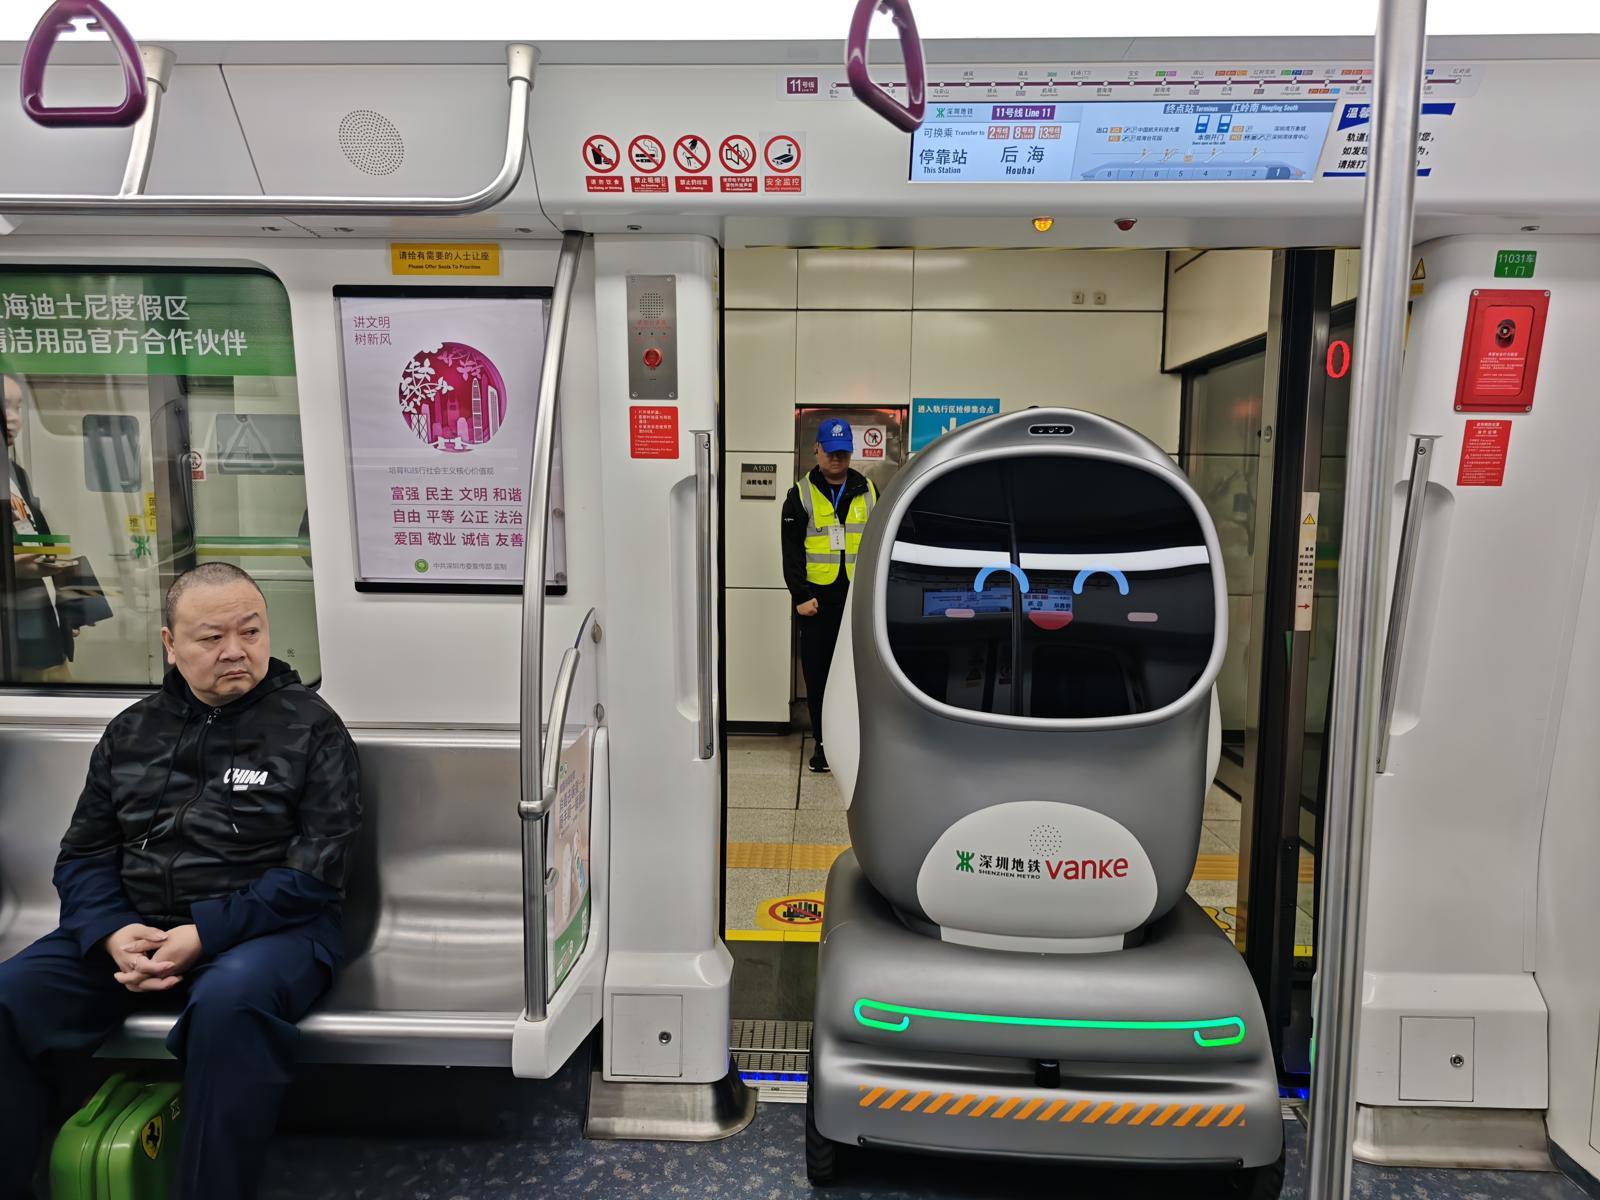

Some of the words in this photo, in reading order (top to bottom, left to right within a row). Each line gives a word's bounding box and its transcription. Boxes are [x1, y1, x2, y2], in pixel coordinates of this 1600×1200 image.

[789, 79, 815, 92] 11号线
[996, 107, 1023, 117] 11号线
[1024, 107, 1040, 117] Line
[1042, 106, 1051, 116] 11
[1167, 104, 1194, 114] 终点站
[924, 127, 953, 139] 可换乘
[919, 148, 968, 165] 停靠站
[1000, 145, 1045, 163] 后海
[923, 166, 936, 174] This
[938, 166, 961, 174] Station
[1006, 166, 1035, 175] Houhai
[766, 178, 800, 186] 安全监控
[0, 293, 190, 320] 海迪士尼度假区
[353, 316, 390, 329] 讲文明
[0, 328, 248, 356] 洁用品官方合作伙伴
[354, 333, 392, 346] 树新风
[391, 486, 420, 501] 富强
[426, 486, 454, 501] 民主
[459, 487, 488, 502] 文明
[493, 488, 522, 502] 和谐
[393, 509, 420, 524] 自由
[426, 510, 454, 524] 平等
[460, 510, 489, 524] 公正
[494, 510, 523, 525] 法治
[394, 532, 422, 546] 爱国
[428, 532, 456, 546] 敬业
[462, 532, 490, 547] 诚信
[496, 532, 524, 548] 友善
[223, 768, 269, 786] CHINA
[979, 854, 1041, 874] 深圳地铁
[1045, 857, 1129, 880] vanke
[978, 870, 1015, 878] SHENZHEN
